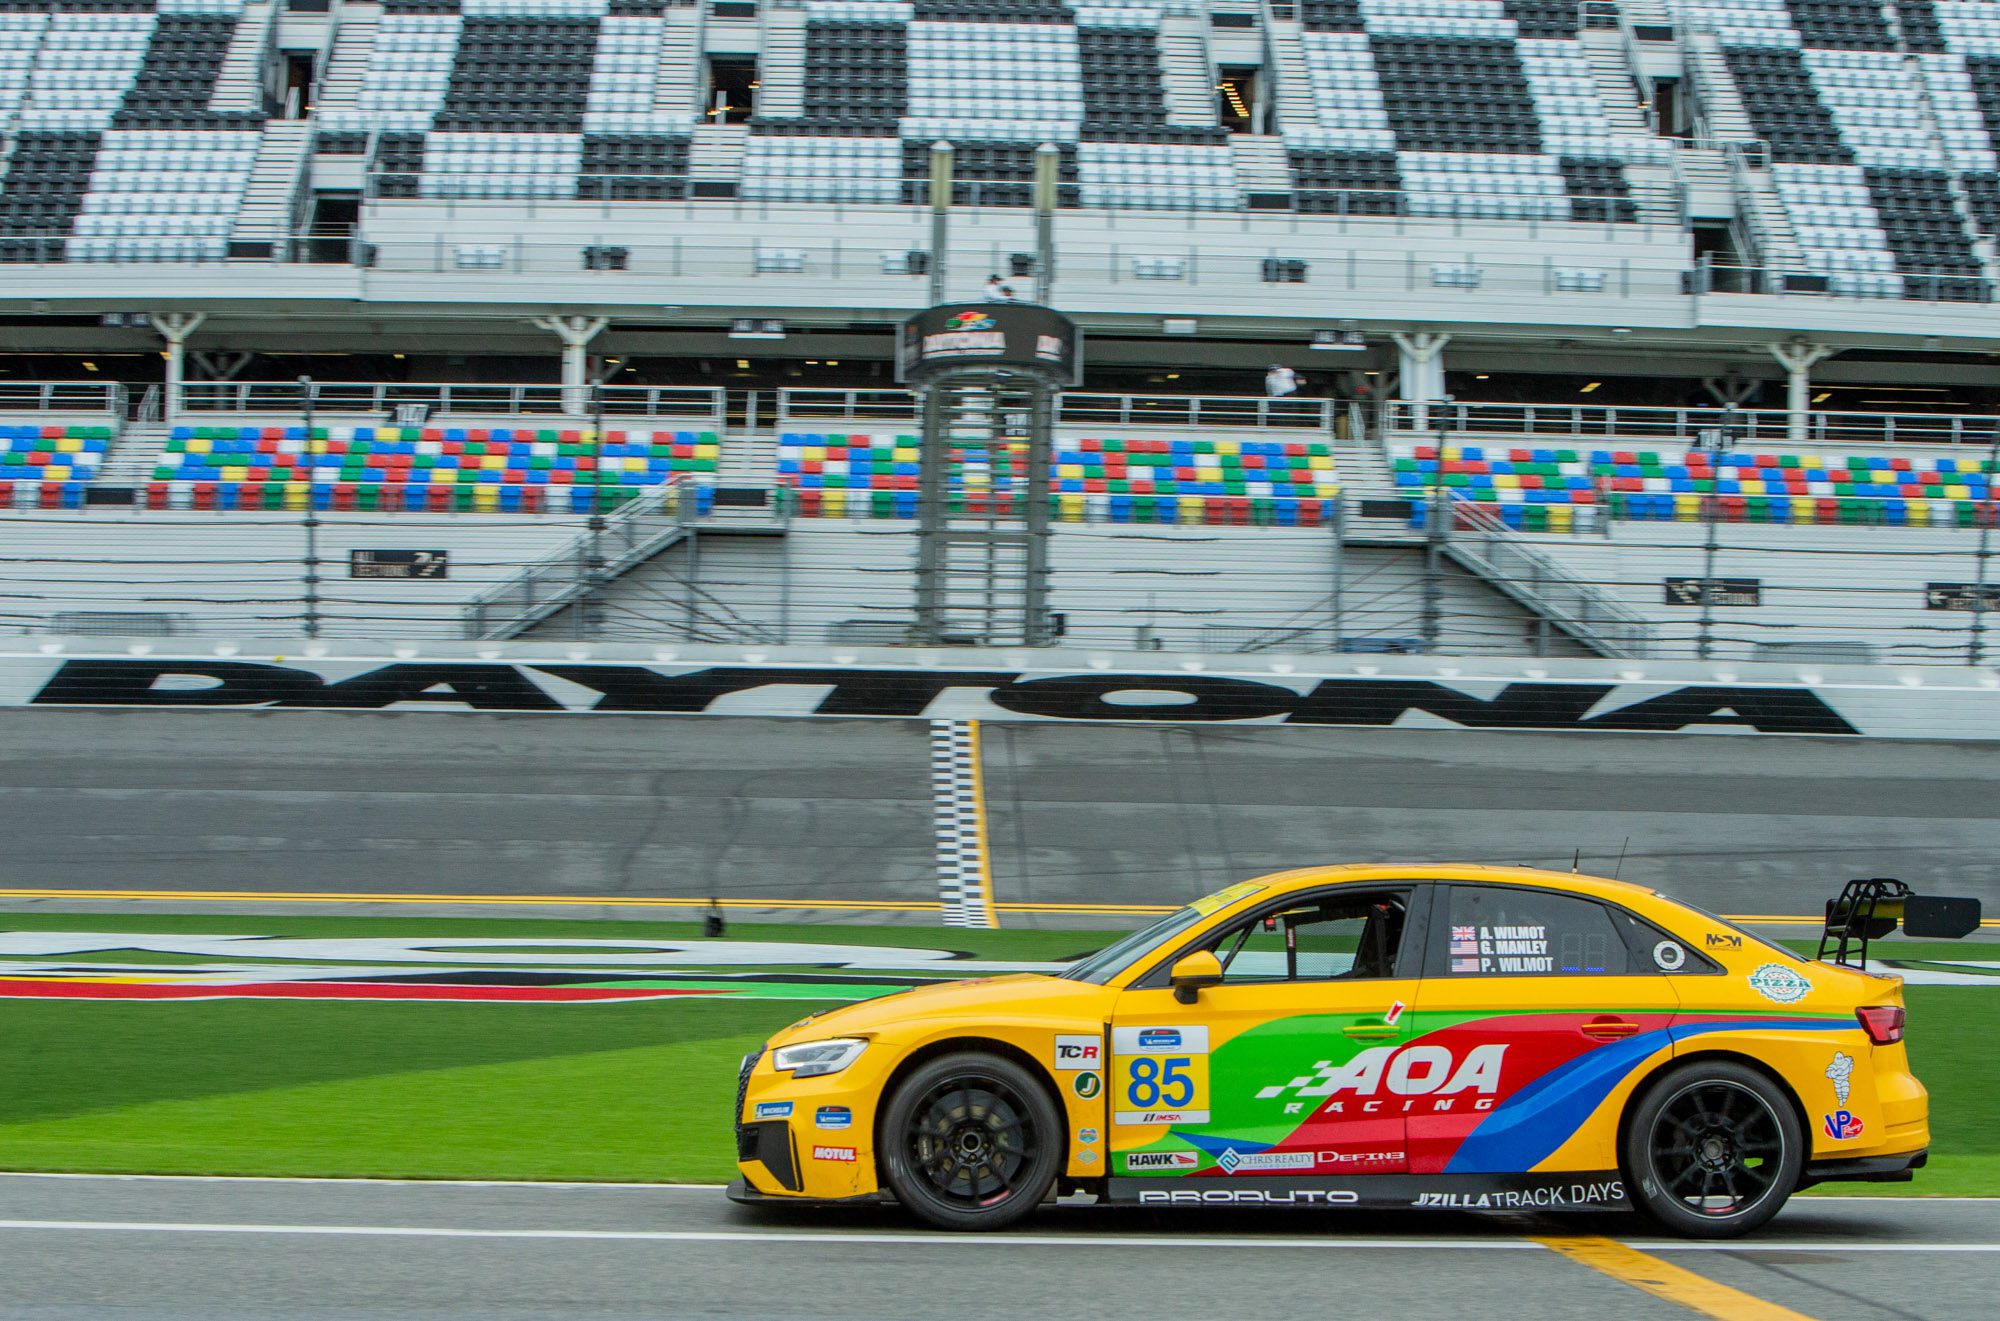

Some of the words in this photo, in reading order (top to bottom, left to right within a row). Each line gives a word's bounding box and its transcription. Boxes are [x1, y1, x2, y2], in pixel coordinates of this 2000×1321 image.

[29, 659, 1863, 736] DAYTONA
[1494, 926, 1545, 940] WILMOT
[1496, 940, 1548, 955] MANLEY
[1499, 957, 1554, 973] WILMOT
[1750, 977, 1811, 988] PIZZA
[1058, 1045, 1098, 1059] TCR
[1295, 1044, 1510, 1096] AOA
[1128, 1057, 1194, 1108] 85
[1284, 1099, 1495, 1114] RACING
[1825, 1110, 1852, 1139] VP
[814, 1147, 856, 1160] MOTUL
[1129, 1154, 1174, 1166] HAWK
[1241, 1155, 1273, 1165] CHRIS
[1275, 1153, 1313, 1163] REALTY
[1139, 1190, 1359, 1203] PROAUTO
[1491, 1186, 1566, 1207] TRACK
[1570, 1181, 1625, 1204] DAYS
